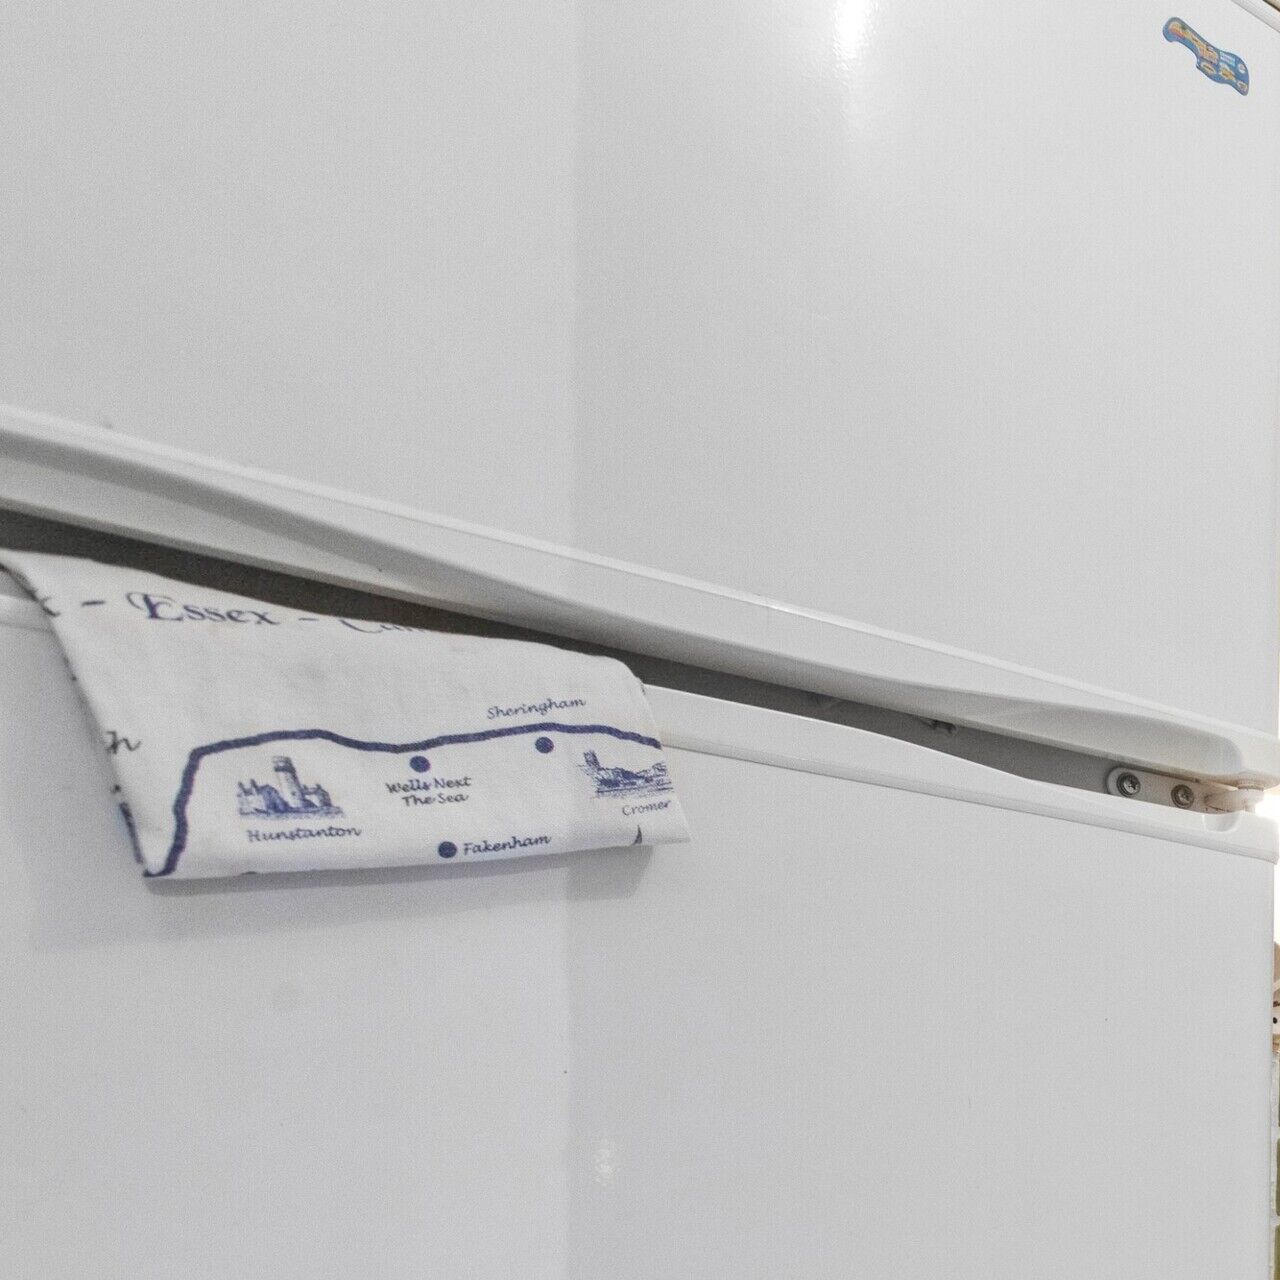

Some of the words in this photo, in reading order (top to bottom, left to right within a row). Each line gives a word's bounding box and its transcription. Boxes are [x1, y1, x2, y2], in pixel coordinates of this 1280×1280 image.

[126, 592, 281, 626] Essex
[486, 697, 586, 721] Sheringham
[385, 779, 431, 794] Wells
[434, 776, 472, 789] Next
[402, 794, 435, 807] The
[437, 792, 470, 804] Sea
[622, 800, 672, 817] Cromer
[247, 825, 362, 843] Hunstanton
[463, 832, 552, 856] Fakenham
